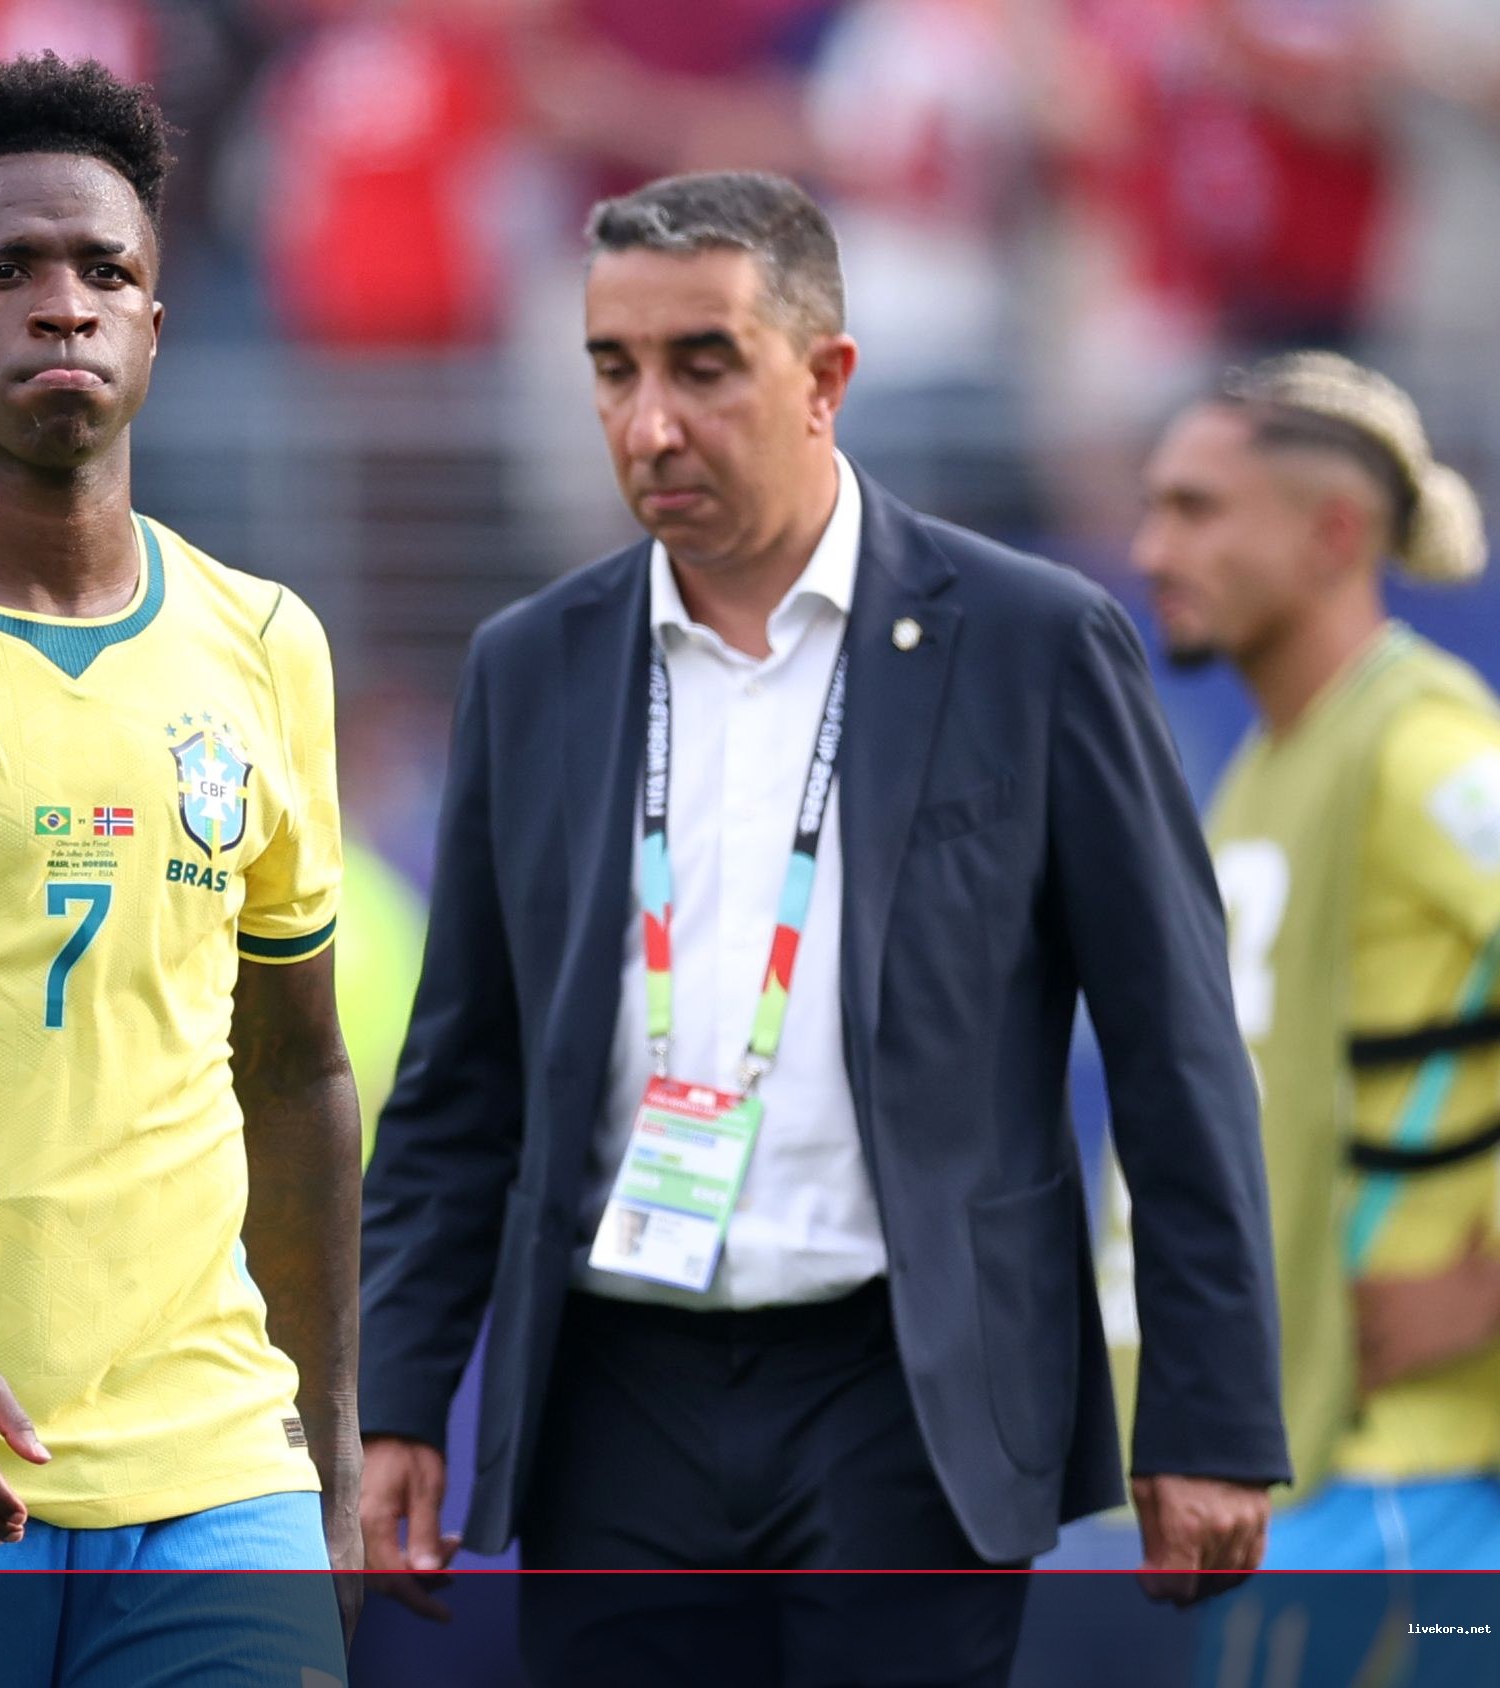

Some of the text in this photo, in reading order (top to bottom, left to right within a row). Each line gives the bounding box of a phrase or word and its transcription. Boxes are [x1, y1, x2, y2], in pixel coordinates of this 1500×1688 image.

[647, 702, 669, 773] WORLD
[816, 719, 843, 765] CUP
[200, 780, 227, 799] CBF
[645, 774, 666, 817] FIFA
[800, 756, 833, 833] 2026
[47, 860, 69, 868] BRASIL
[82, 860, 118, 868] NORUEGA
[44, 882, 114, 1030] 7
